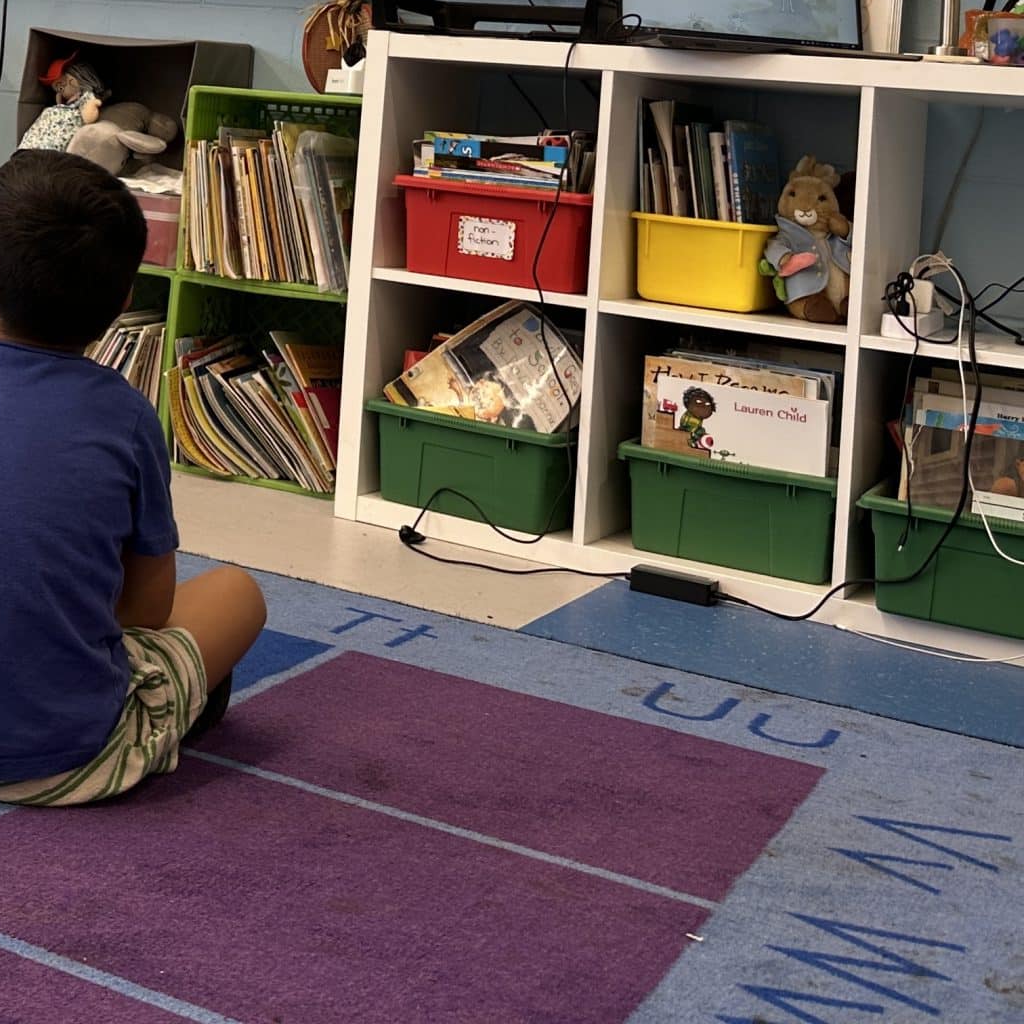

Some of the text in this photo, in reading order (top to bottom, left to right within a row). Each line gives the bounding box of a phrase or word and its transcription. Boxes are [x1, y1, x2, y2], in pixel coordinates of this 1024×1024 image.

[466, 234, 499, 247] fiction
[734, 402, 807, 423] Lauren Child
